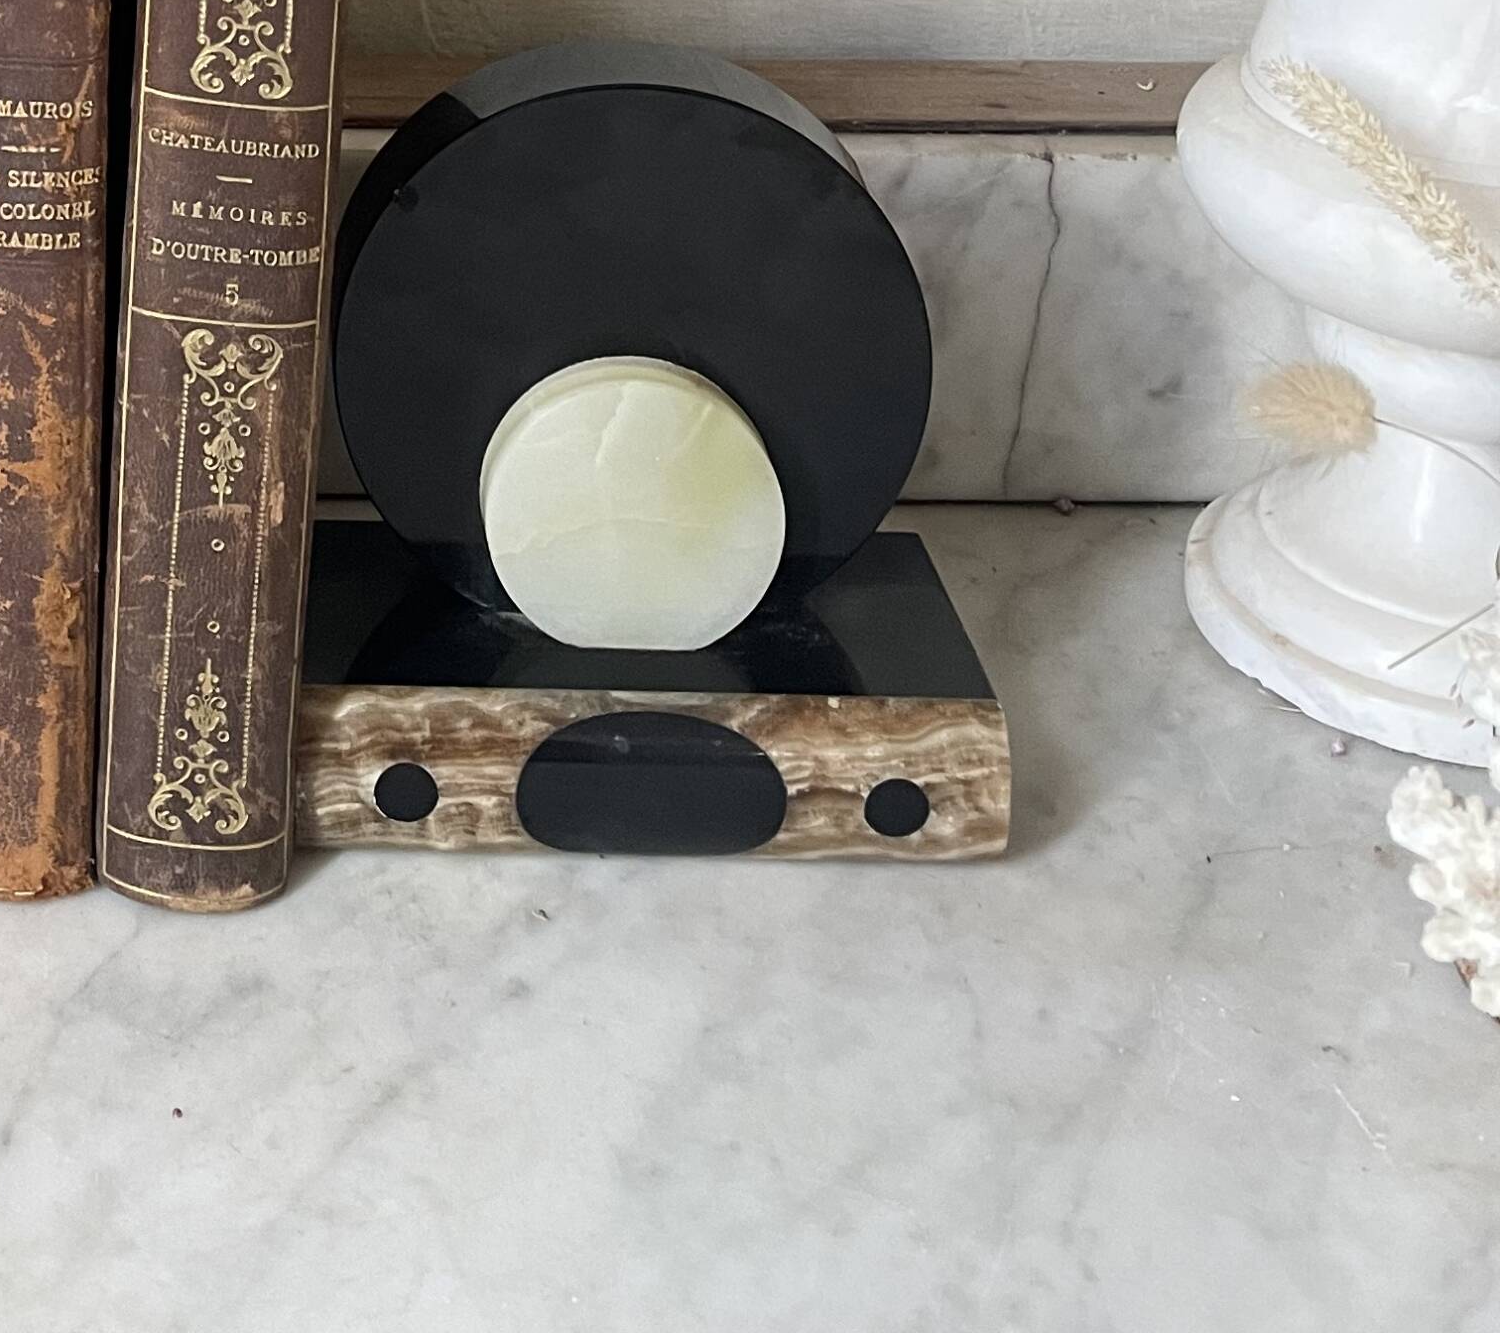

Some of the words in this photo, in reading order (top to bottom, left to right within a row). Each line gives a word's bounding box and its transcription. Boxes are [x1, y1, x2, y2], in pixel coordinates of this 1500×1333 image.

[148, 128, 321, 159] CHATEAUBRIAND
[0, 200, 97, 221] COLONEL
[151, 237, 322, 268] D'OUTRE-TOMBE
[224, 283, 240, 307] 5
